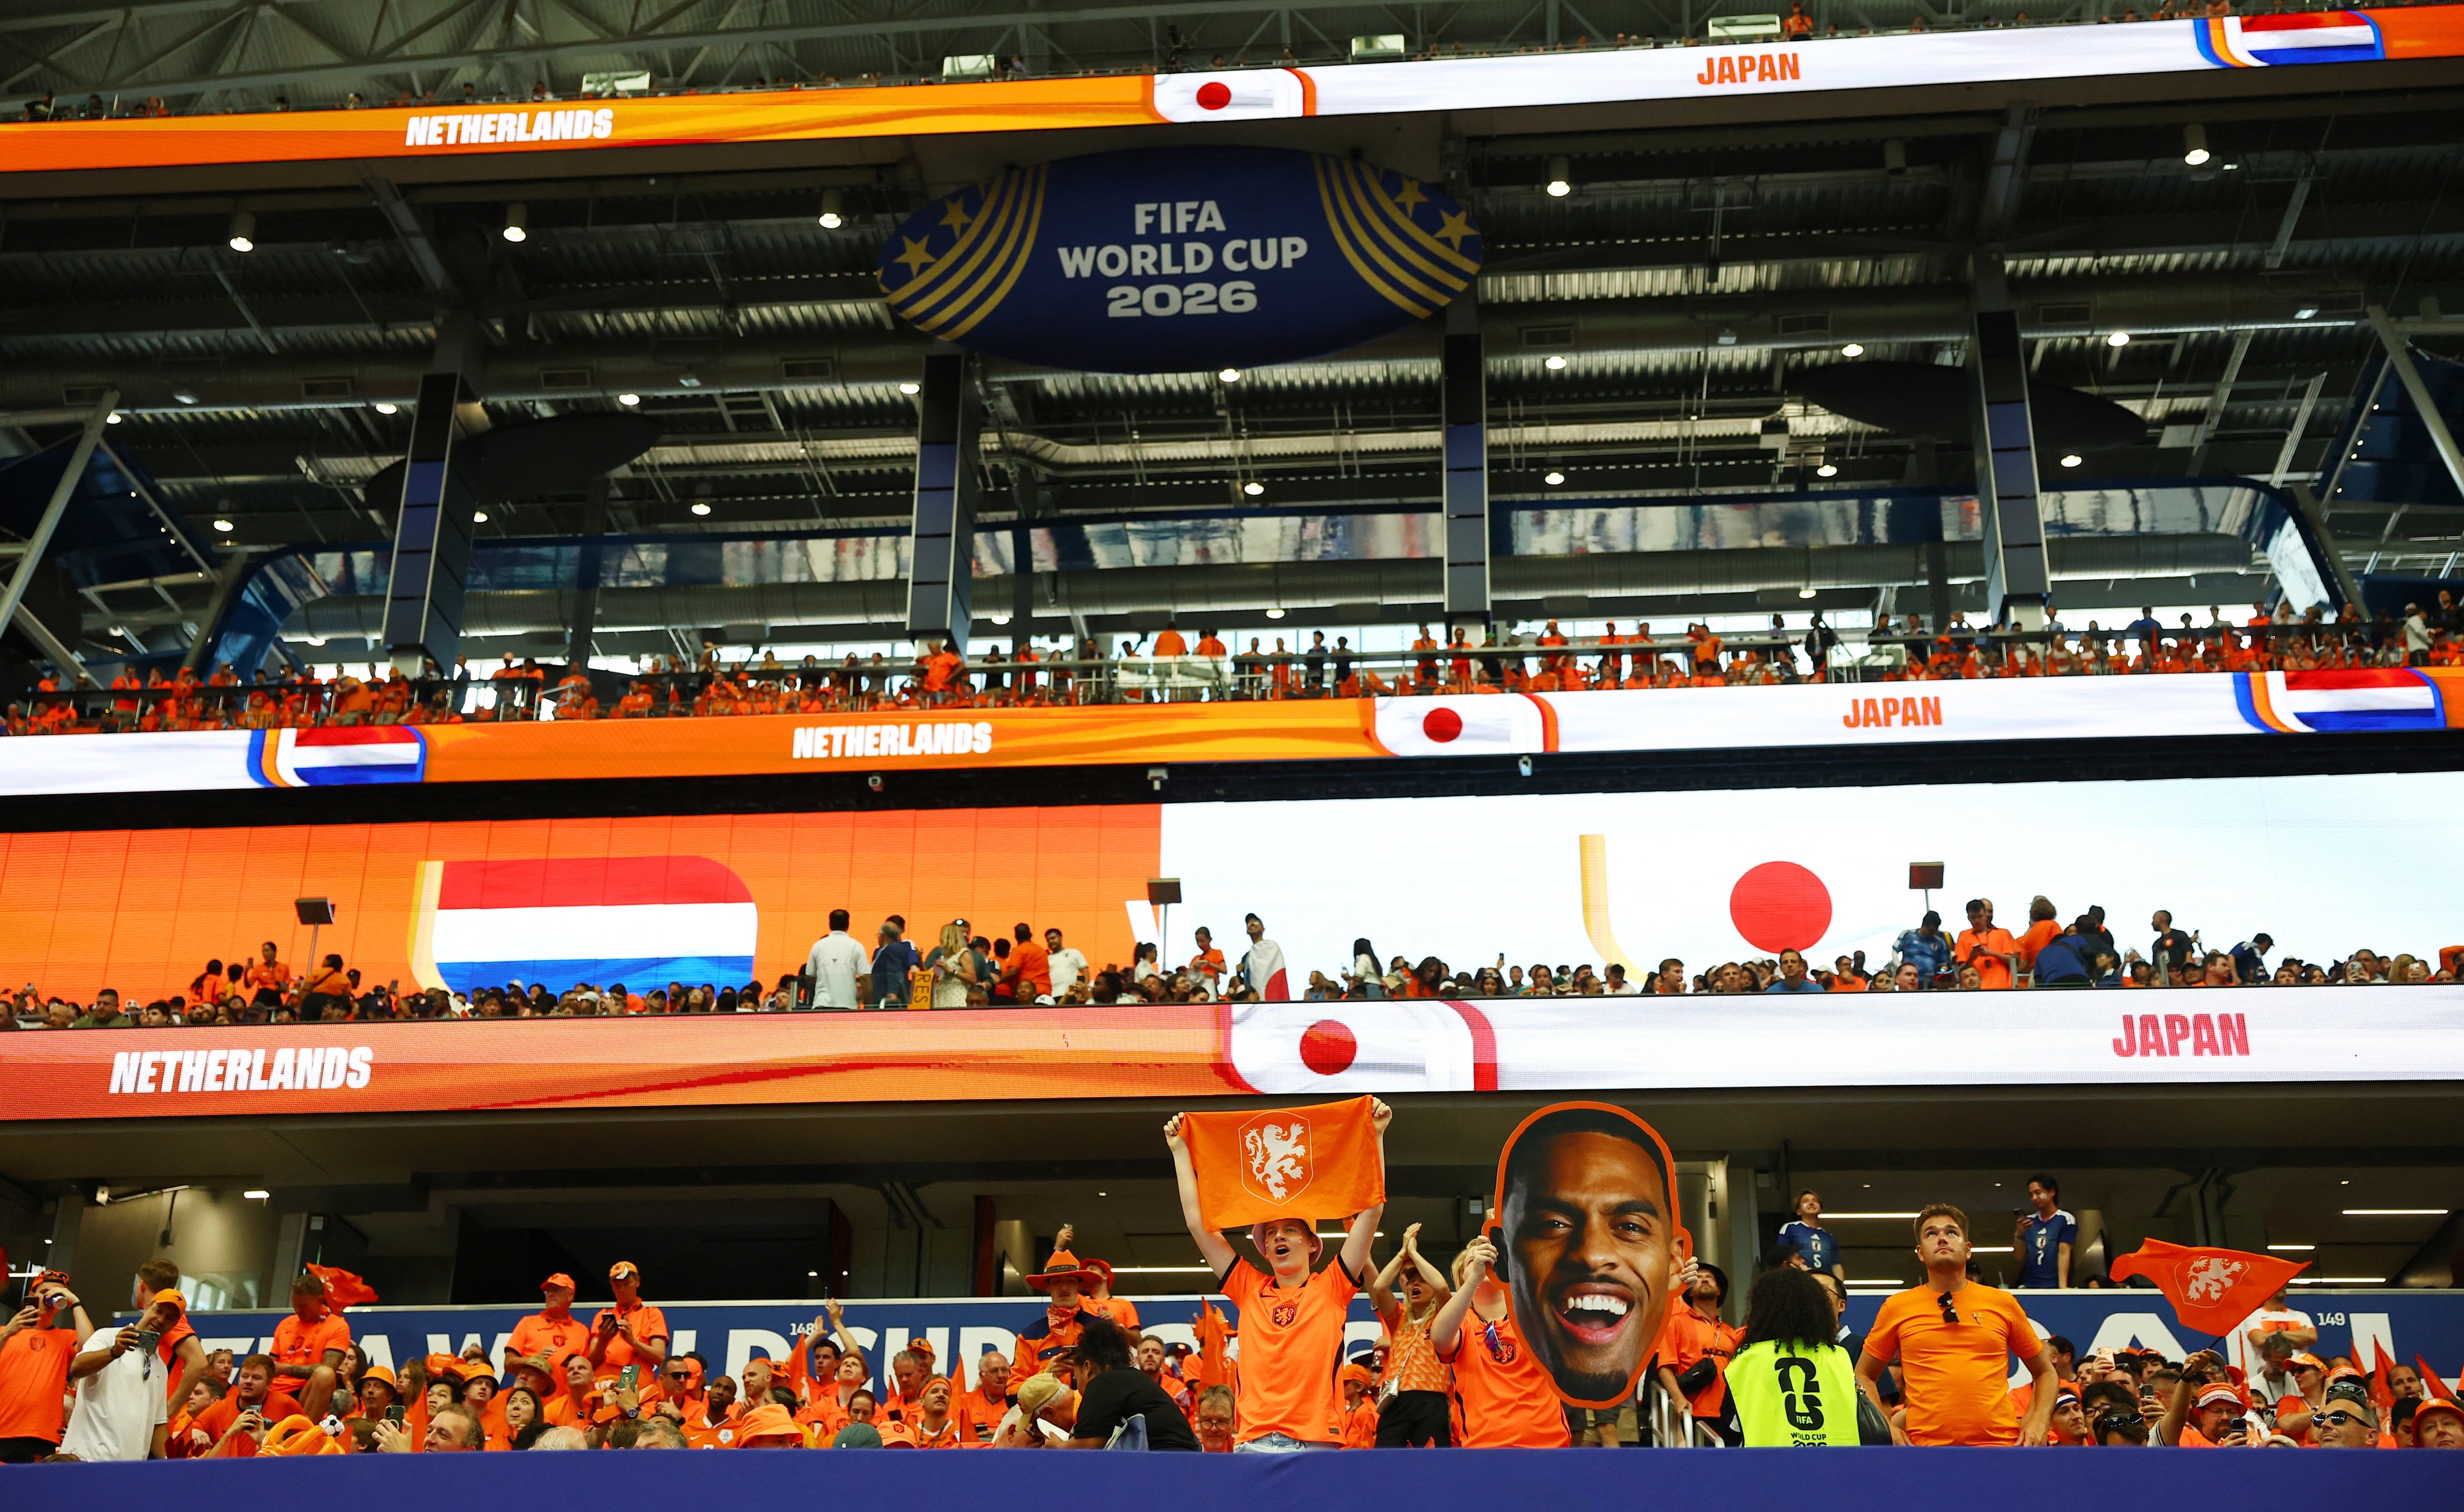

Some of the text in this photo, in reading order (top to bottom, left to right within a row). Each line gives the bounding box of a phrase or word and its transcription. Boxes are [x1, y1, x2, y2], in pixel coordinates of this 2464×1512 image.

[1697, 53, 1799, 85] JAPAN
[406, 108, 613, 146] NETHERLANDS
[1135, 200, 1226, 235] FIFA
[1057, 237, 1308, 278] WORLD CUP
[1107, 281, 1257, 317] 2026
[1844, 696, 1942, 728] JAPAN
[792, 722, 992, 758] NETHERLANDS
[2112, 1012, 2250, 1057] JAPAN
[109, 1046, 374, 1094] NETHERLANDS
[789, 1322, 815, 1336] 148
[2317, 1312, 2346, 1327] 149
[1795, 1415, 1813, 1424] FIFA
